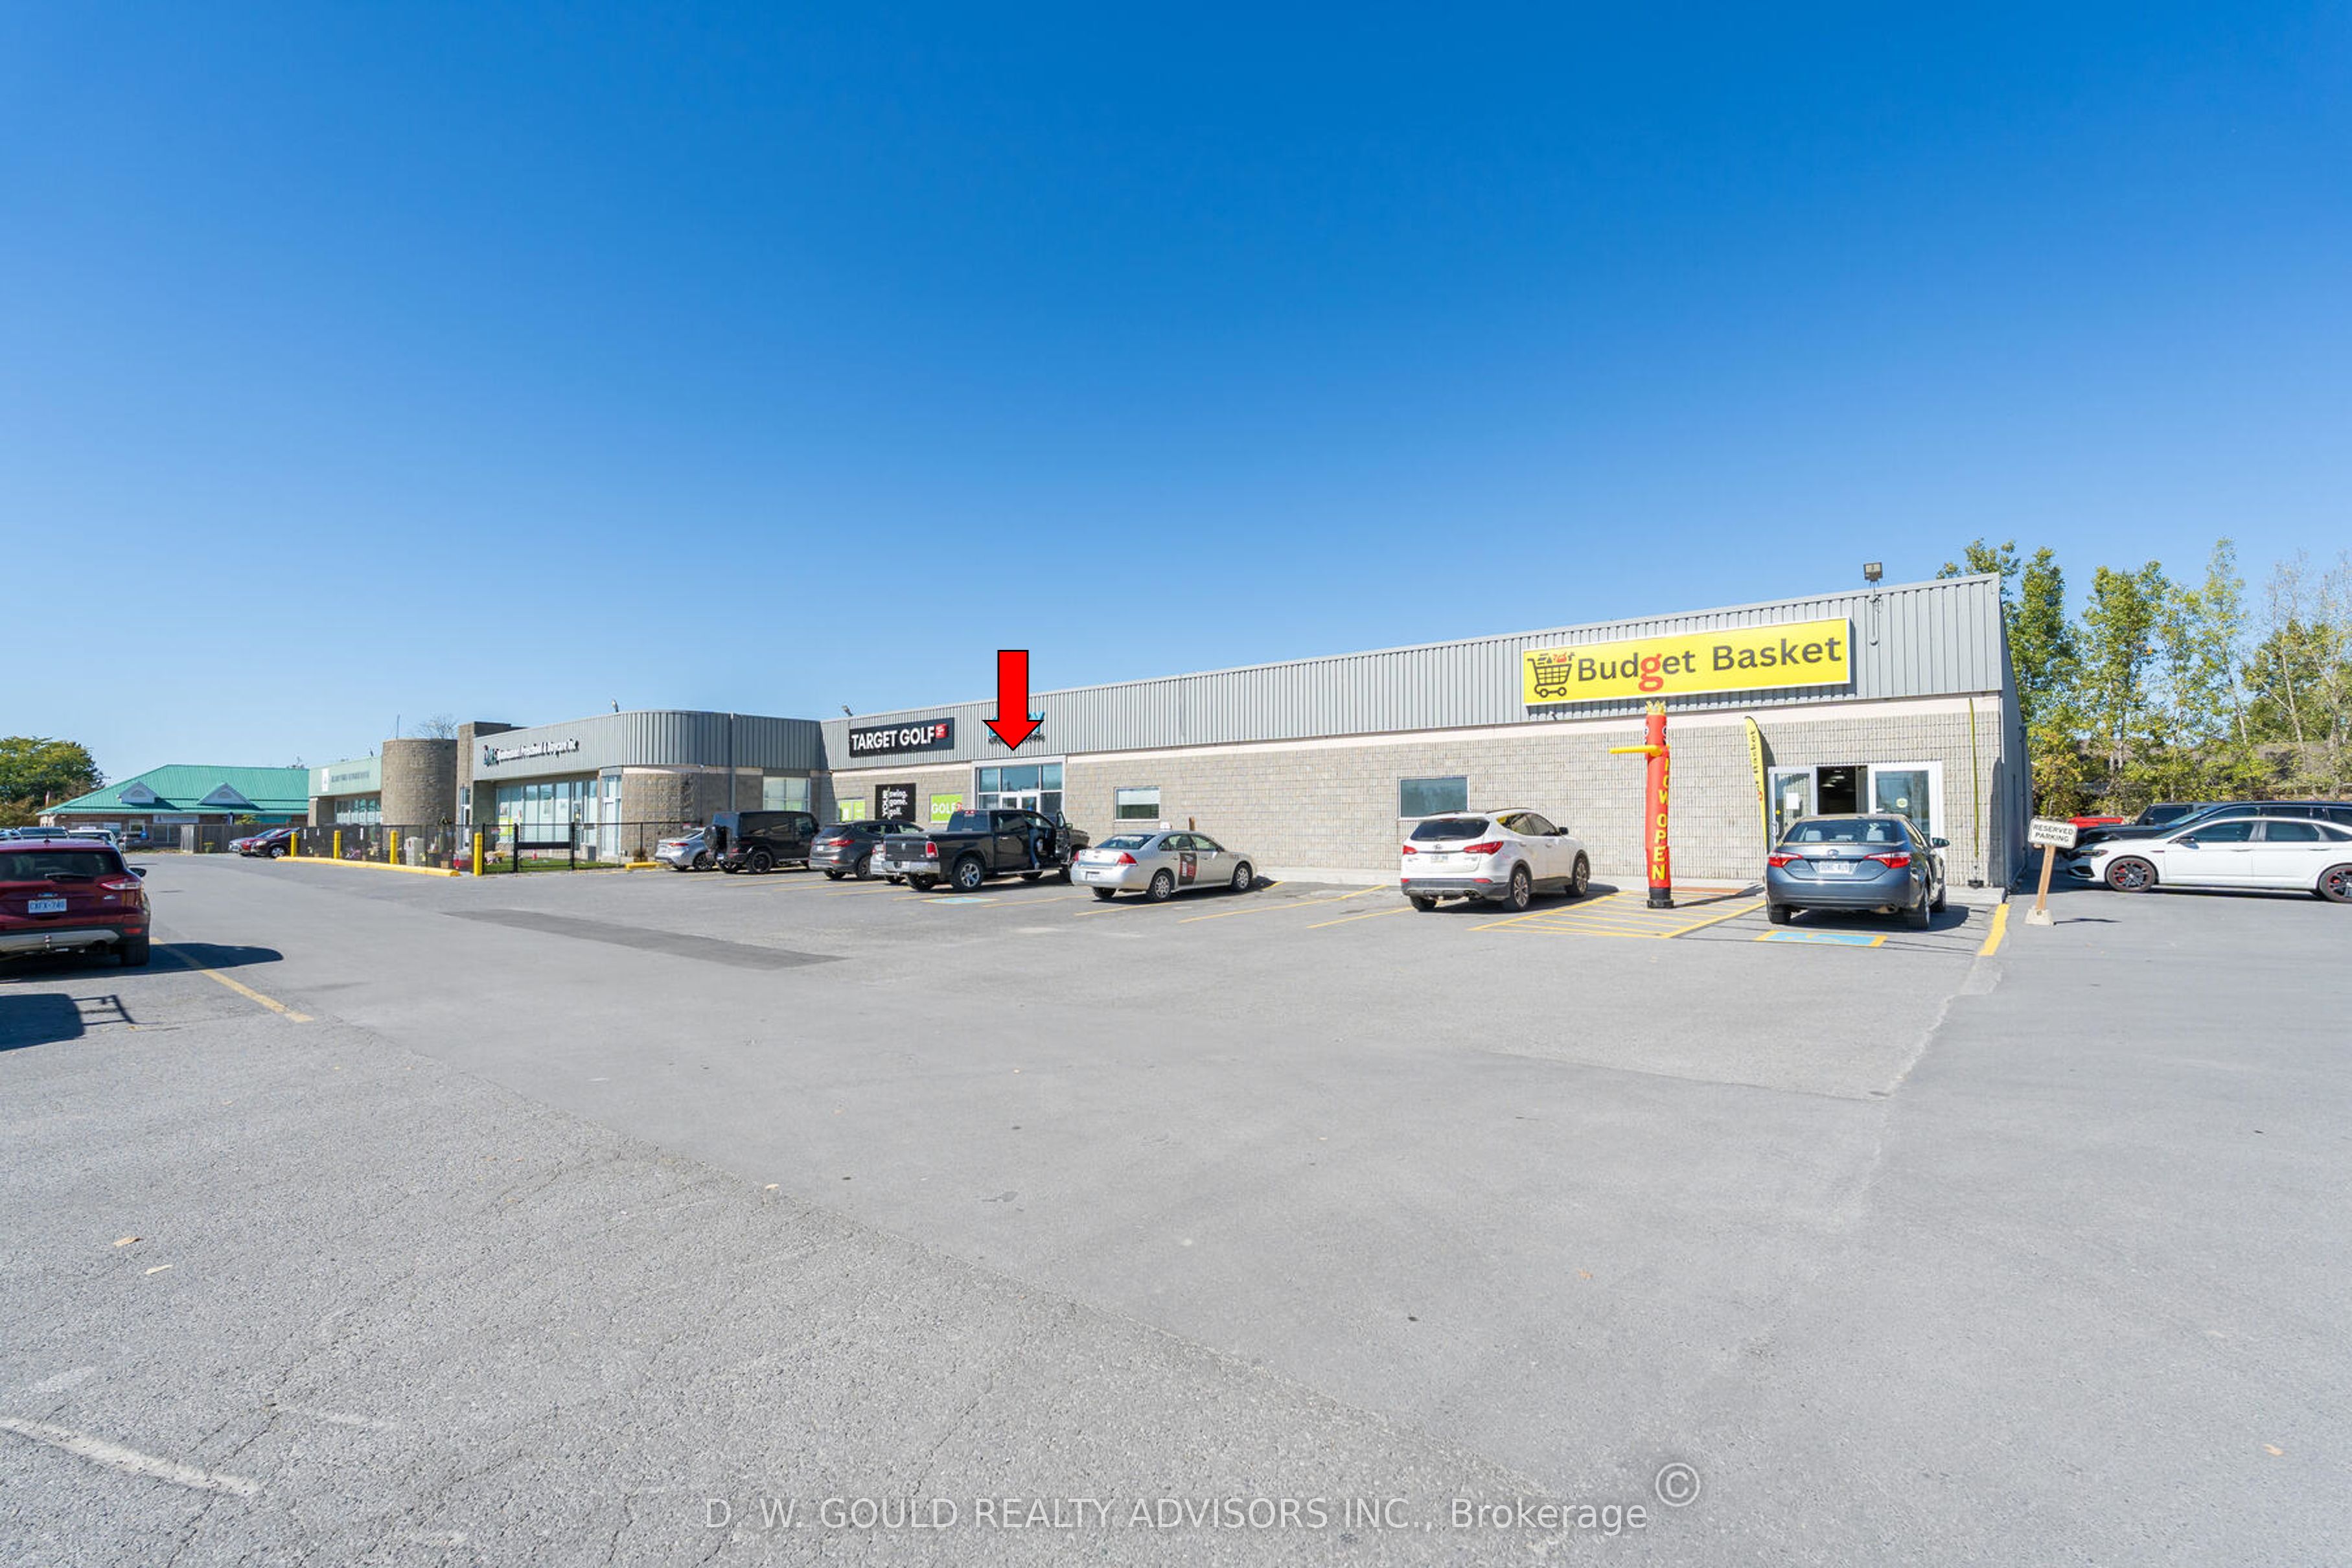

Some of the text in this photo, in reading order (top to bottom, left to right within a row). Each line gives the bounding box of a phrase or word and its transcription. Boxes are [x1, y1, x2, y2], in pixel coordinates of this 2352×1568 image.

[1578, 637, 1841, 692] Budget Basket
[851, 730, 898, 750] TARGET
[899, 726, 935, 746] GOLF
[931, 802, 956, 814] GOLF
[2033, 824, 2074, 835] RESERVED
[2035, 832, 2069, 842] PARKING
[1652, 813, 1668, 881] OPEN
